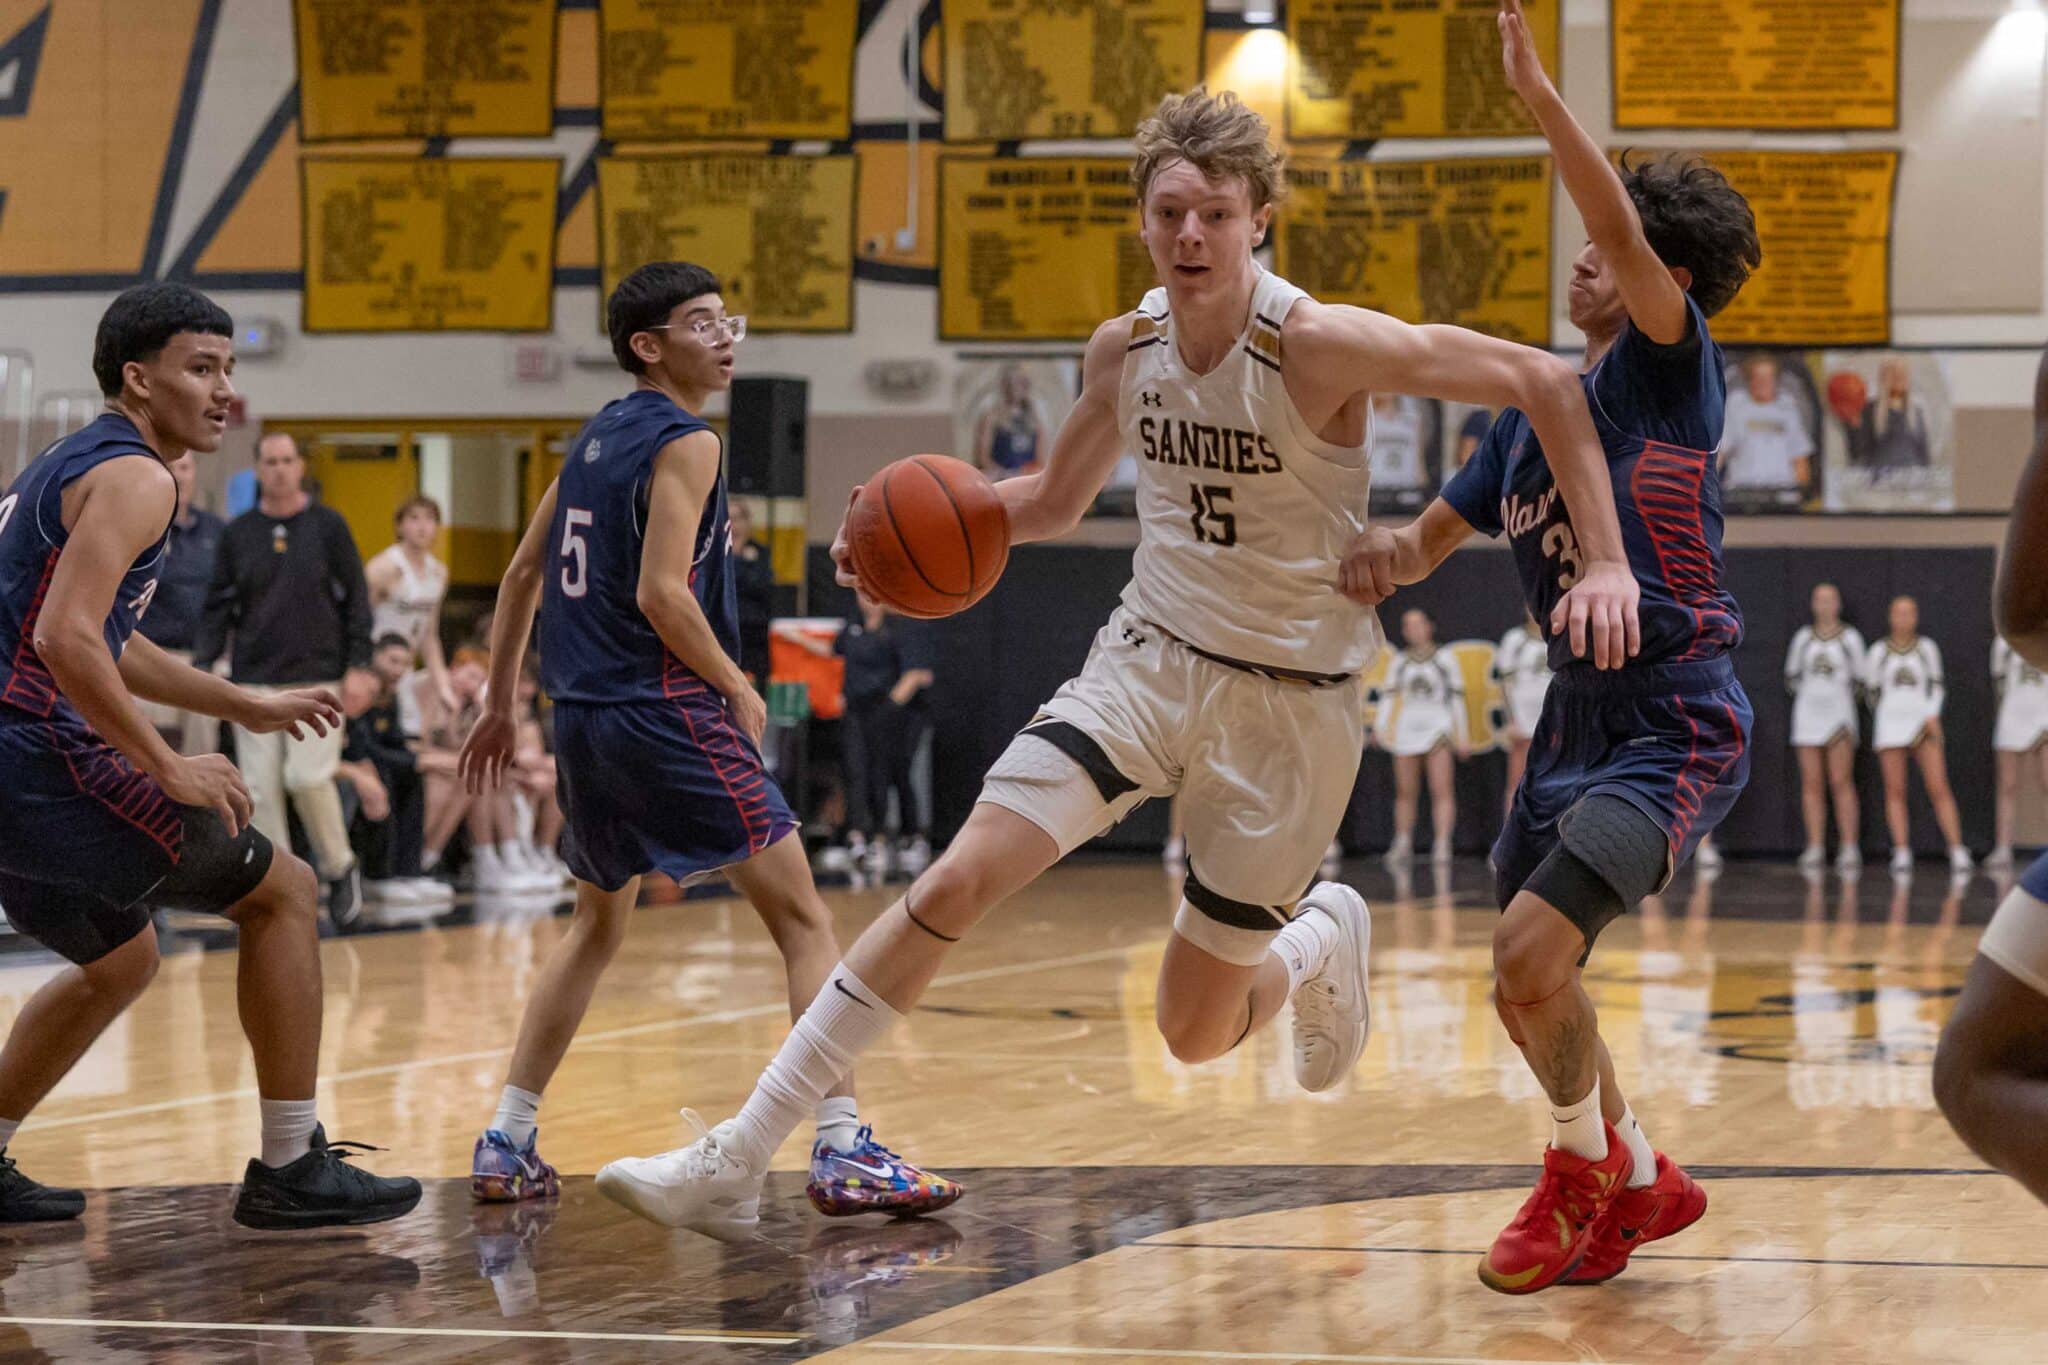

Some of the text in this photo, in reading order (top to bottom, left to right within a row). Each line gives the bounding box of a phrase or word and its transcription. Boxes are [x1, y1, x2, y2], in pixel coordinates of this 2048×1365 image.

[1139, 416, 1283, 475] SANDIES
[1190, 483, 1237, 547] 15
[560, 507, 593, 598] 5
